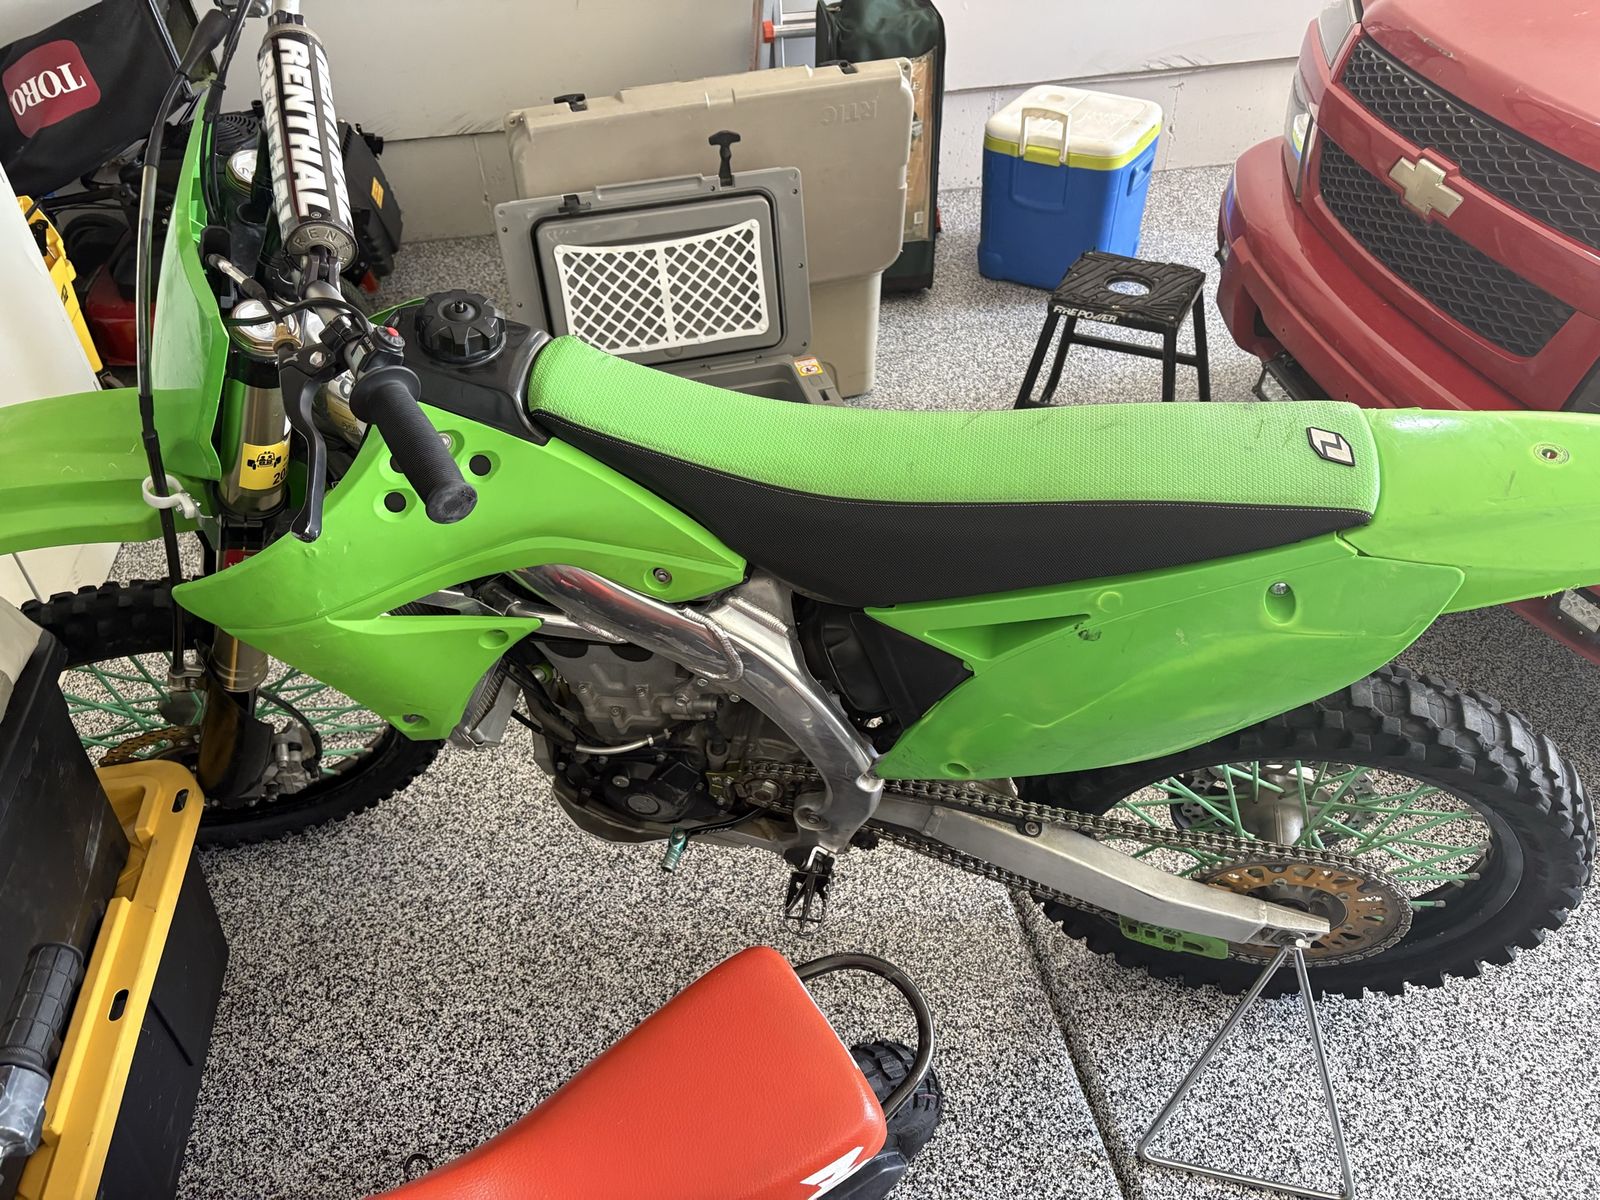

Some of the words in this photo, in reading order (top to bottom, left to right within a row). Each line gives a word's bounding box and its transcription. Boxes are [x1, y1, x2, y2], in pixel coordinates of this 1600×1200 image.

[12, 62, 87, 116] TORO
[821, 99, 879, 126] RTIC
[278, 38, 331, 216] RENTHAL
